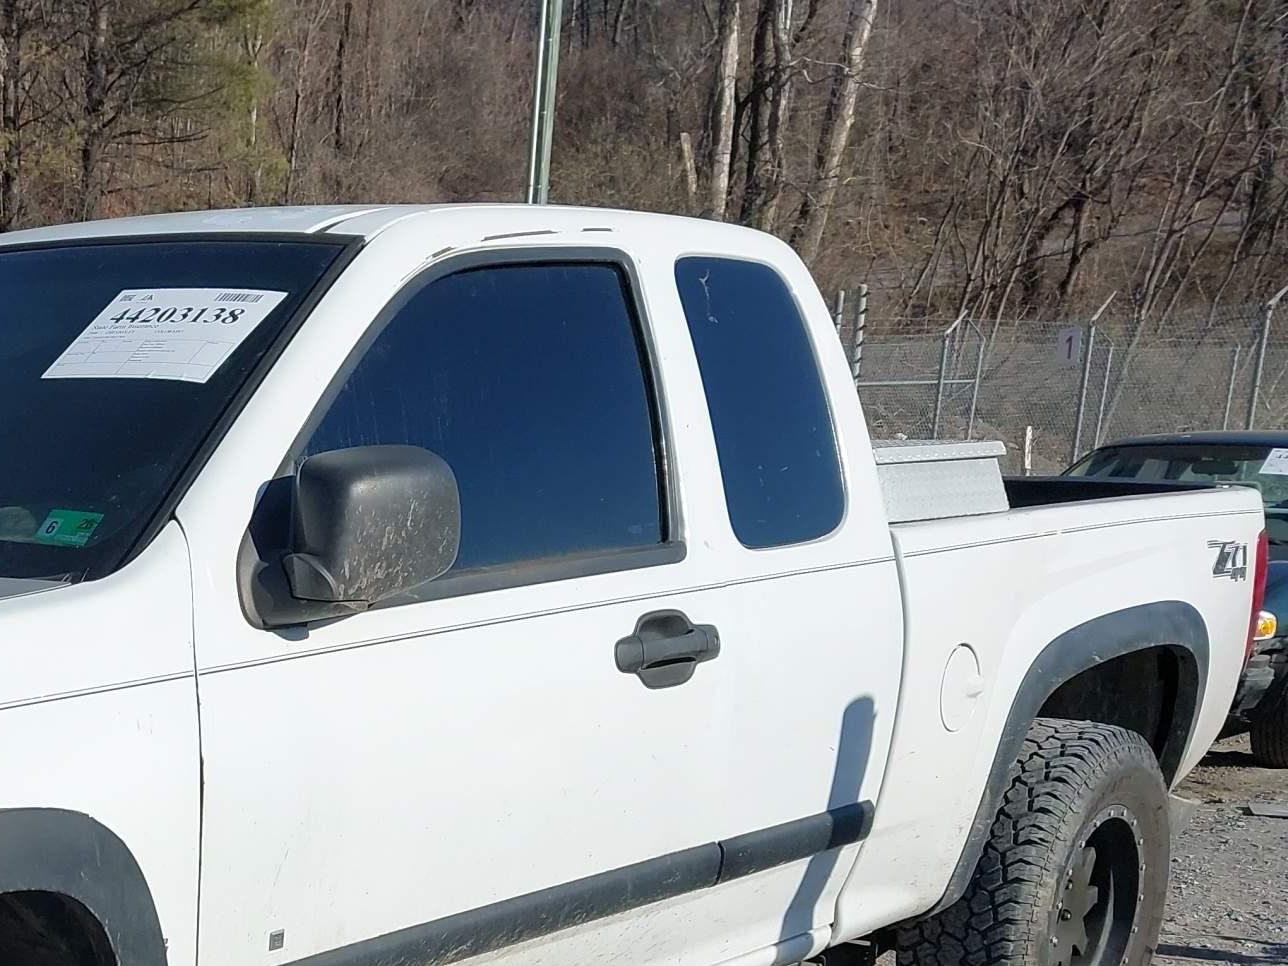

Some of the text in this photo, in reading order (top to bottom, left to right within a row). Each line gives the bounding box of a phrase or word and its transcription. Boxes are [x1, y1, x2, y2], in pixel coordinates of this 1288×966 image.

[109, 306, 246, 325] 44203138
[1065, 335, 1073, 360] 1
[45, 520, 59, 535] 6
[1207, 540, 1248, 579] Z71
